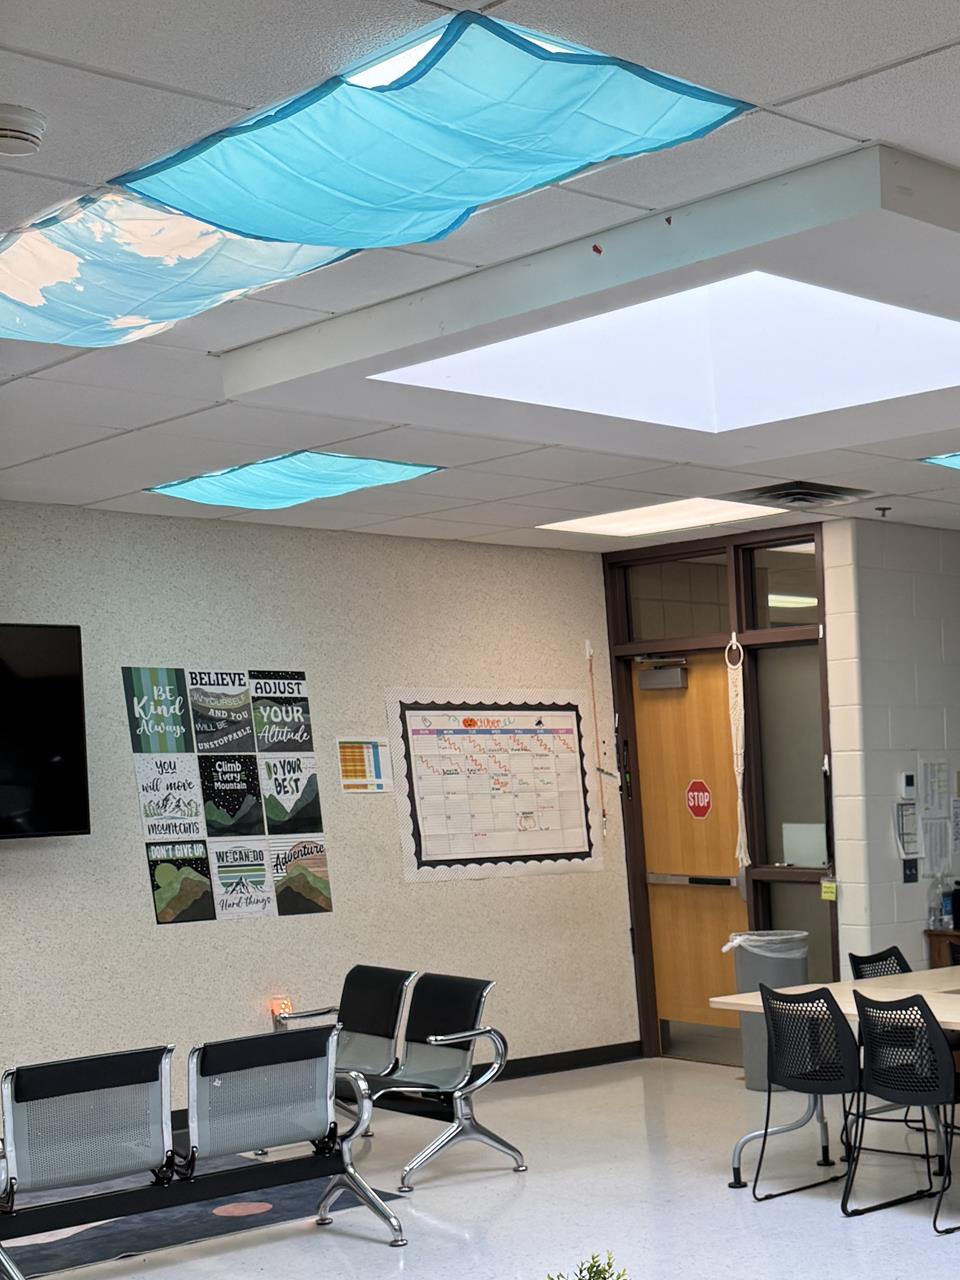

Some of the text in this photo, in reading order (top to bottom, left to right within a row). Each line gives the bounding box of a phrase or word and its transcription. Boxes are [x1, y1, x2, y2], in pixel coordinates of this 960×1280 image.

[189, 671, 247, 687] BELIEVE
[153, 686, 175, 700] BE
[255, 681, 302, 694] ADJUST
[133, 695, 185, 720] Kind
[204, 694, 246, 706] YOURSELF
[208, 708, 249, 721] AND YOU
[259, 706, 305, 723] YOUR
[136, 719, 186, 738] Always
[195, 719, 228, 732] WILL BE
[198, 725, 252, 750] UNSTOPPABLE
[257, 724, 310, 744] Altitude
[155, 760, 177, 775] you
[215, 761, 242, 772] Climb
[279, 757, 303, 776] YOUR
[218, 771, 241, 782] Every
[142, 777, 195, 792] will move
[214, 781, 247, 790] Mountain
[274, 776, 301, 795] BEST
[688, 791, 710, 807] STOP
[147, 821, 200, 835] mountains
[150, 843, 204, 859] DON'T GIVE UP
[216, 850, 264, 863] WE CAN DO
[273, 844, 326, 874] Adventure
[219, 895, 271, 911] Hard things
